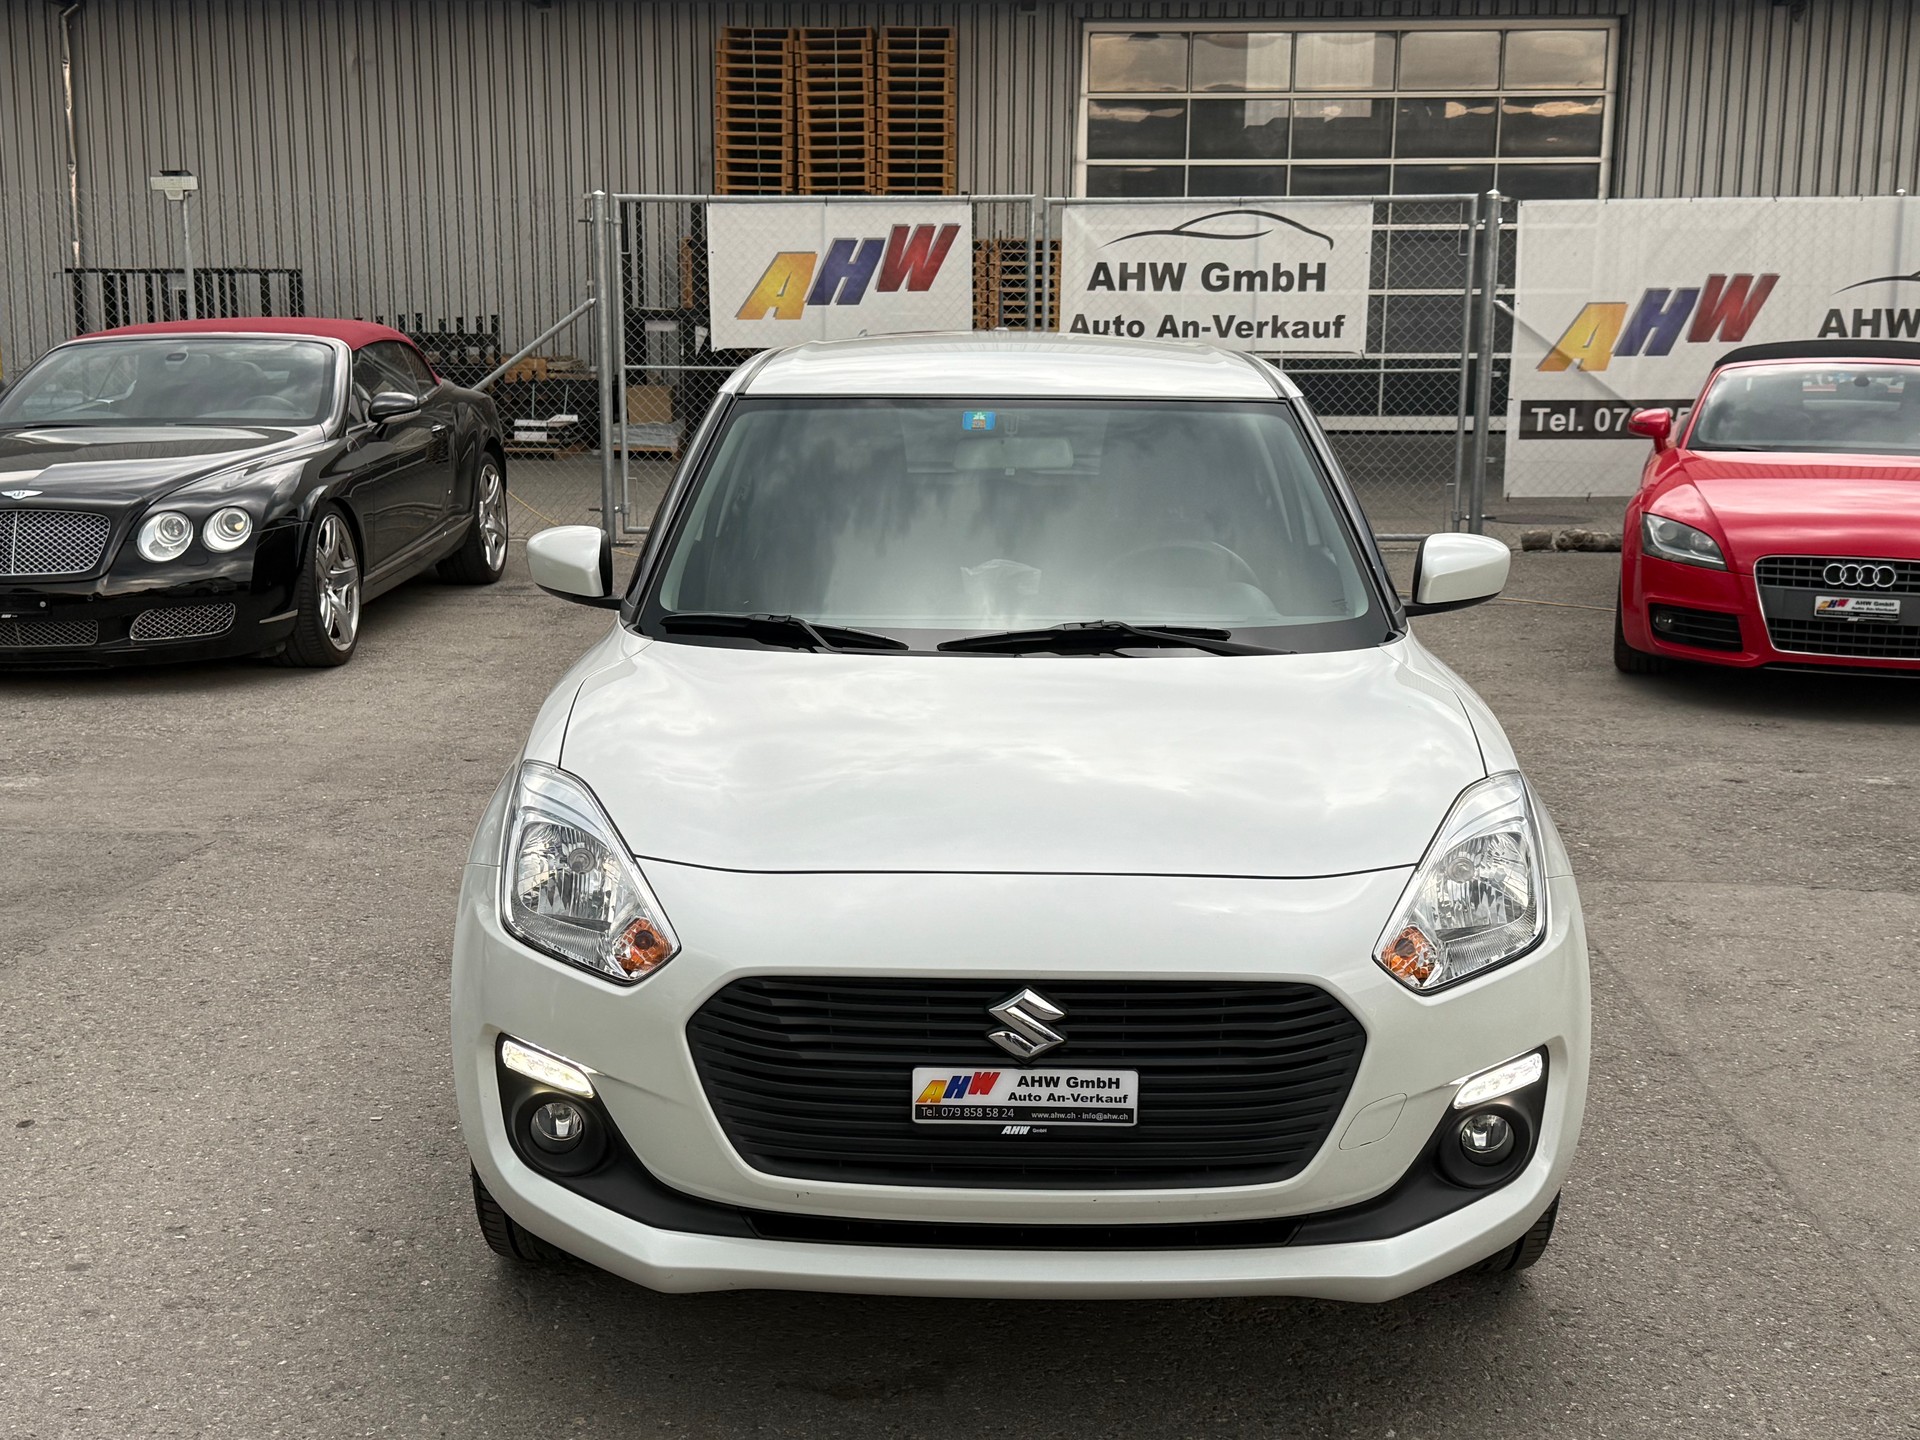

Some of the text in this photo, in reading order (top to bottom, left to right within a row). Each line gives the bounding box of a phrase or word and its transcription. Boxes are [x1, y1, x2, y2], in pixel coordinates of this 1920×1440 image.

[734, 223, 960, 320] AHW
[1087, 262, 1327, 293] AHW GmbH
[1069, 313, 1346, 339] Auto An-Verkauf
[1536, 273, 1780, 372] AHW
[1817, 308, 1920, 338] AHW
[1531, 407, 1583, 432] Tel.
[1594, 407, 1644, 432] 07
[915, 1071, 1001, 1104] AHW
[1017, 1075, 1120, 1090] AHW GmbH
[1007, 1091, 1128, 1104] Auto An-Verkauf
[921, 1107, 939, 1117] Tel.
[941, 1107, 961, 1117] 079
[963, 1107, 983, 1117] 858
[986, 1108, 999, 1118] 58
[1001, 1108, 1014, 1118] 24
[1031, 1111, 1076, 1119] www.ahw.ch
[1082, 1112, 1128, 1121] info@ahw.ch
[1001, 1126, 1030, 1135] AHW
